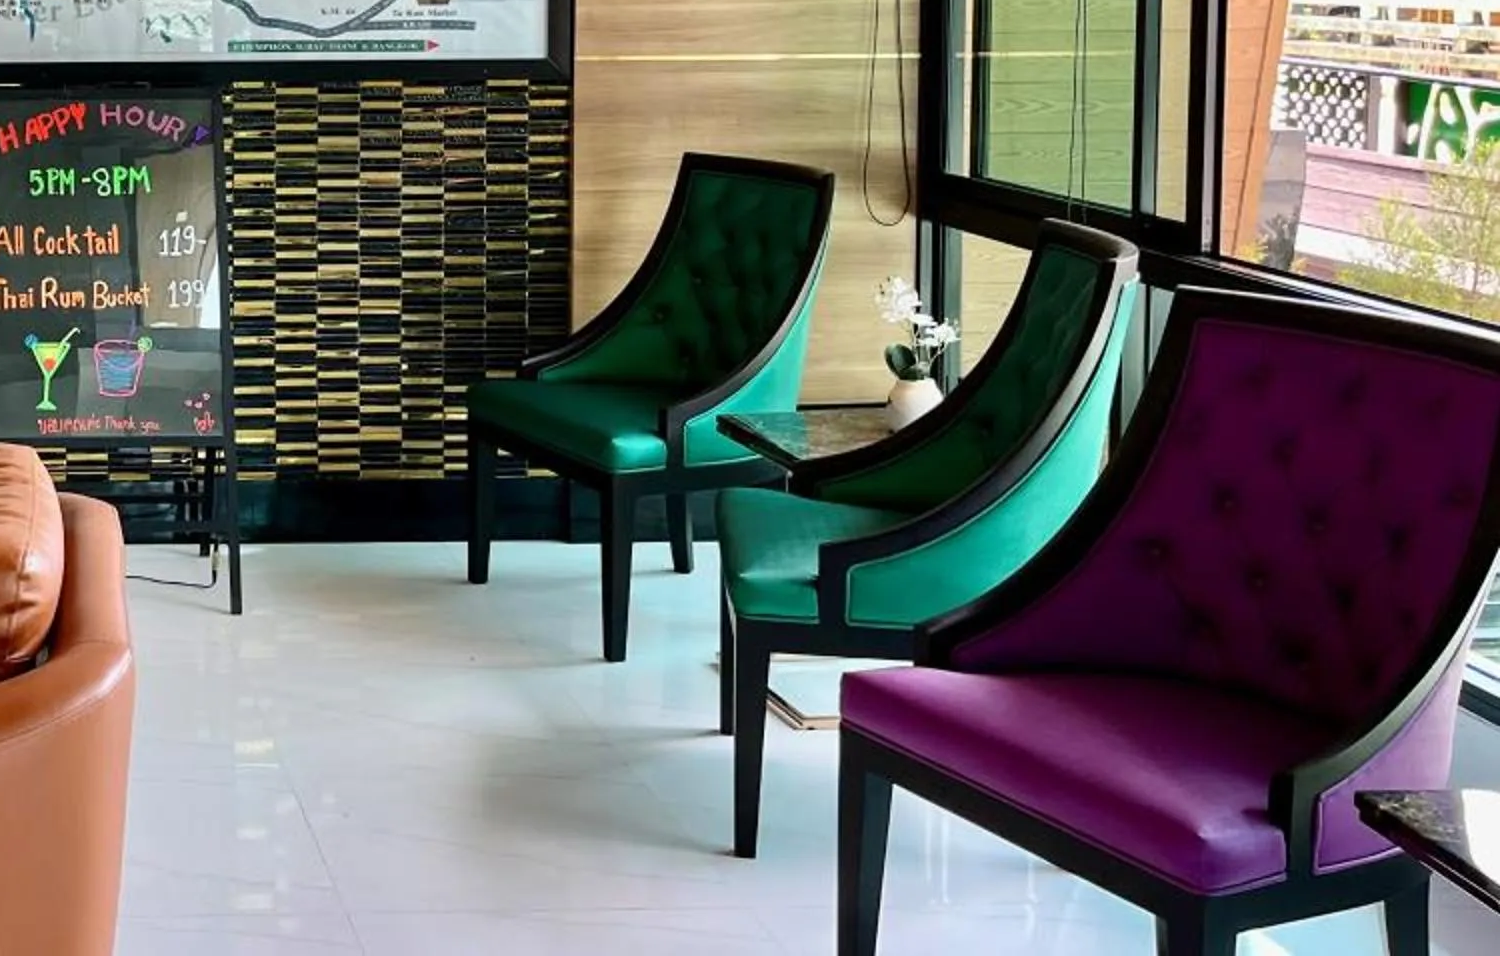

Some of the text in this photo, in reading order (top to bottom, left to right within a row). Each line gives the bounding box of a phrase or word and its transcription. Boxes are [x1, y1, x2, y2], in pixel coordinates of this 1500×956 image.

[99, 103, 188, 142] HOUR
[33, 224, 120, 256] Cocktail
[41, 277, 85, 309] Rum
[93, 281, 150, 309] Bucket
